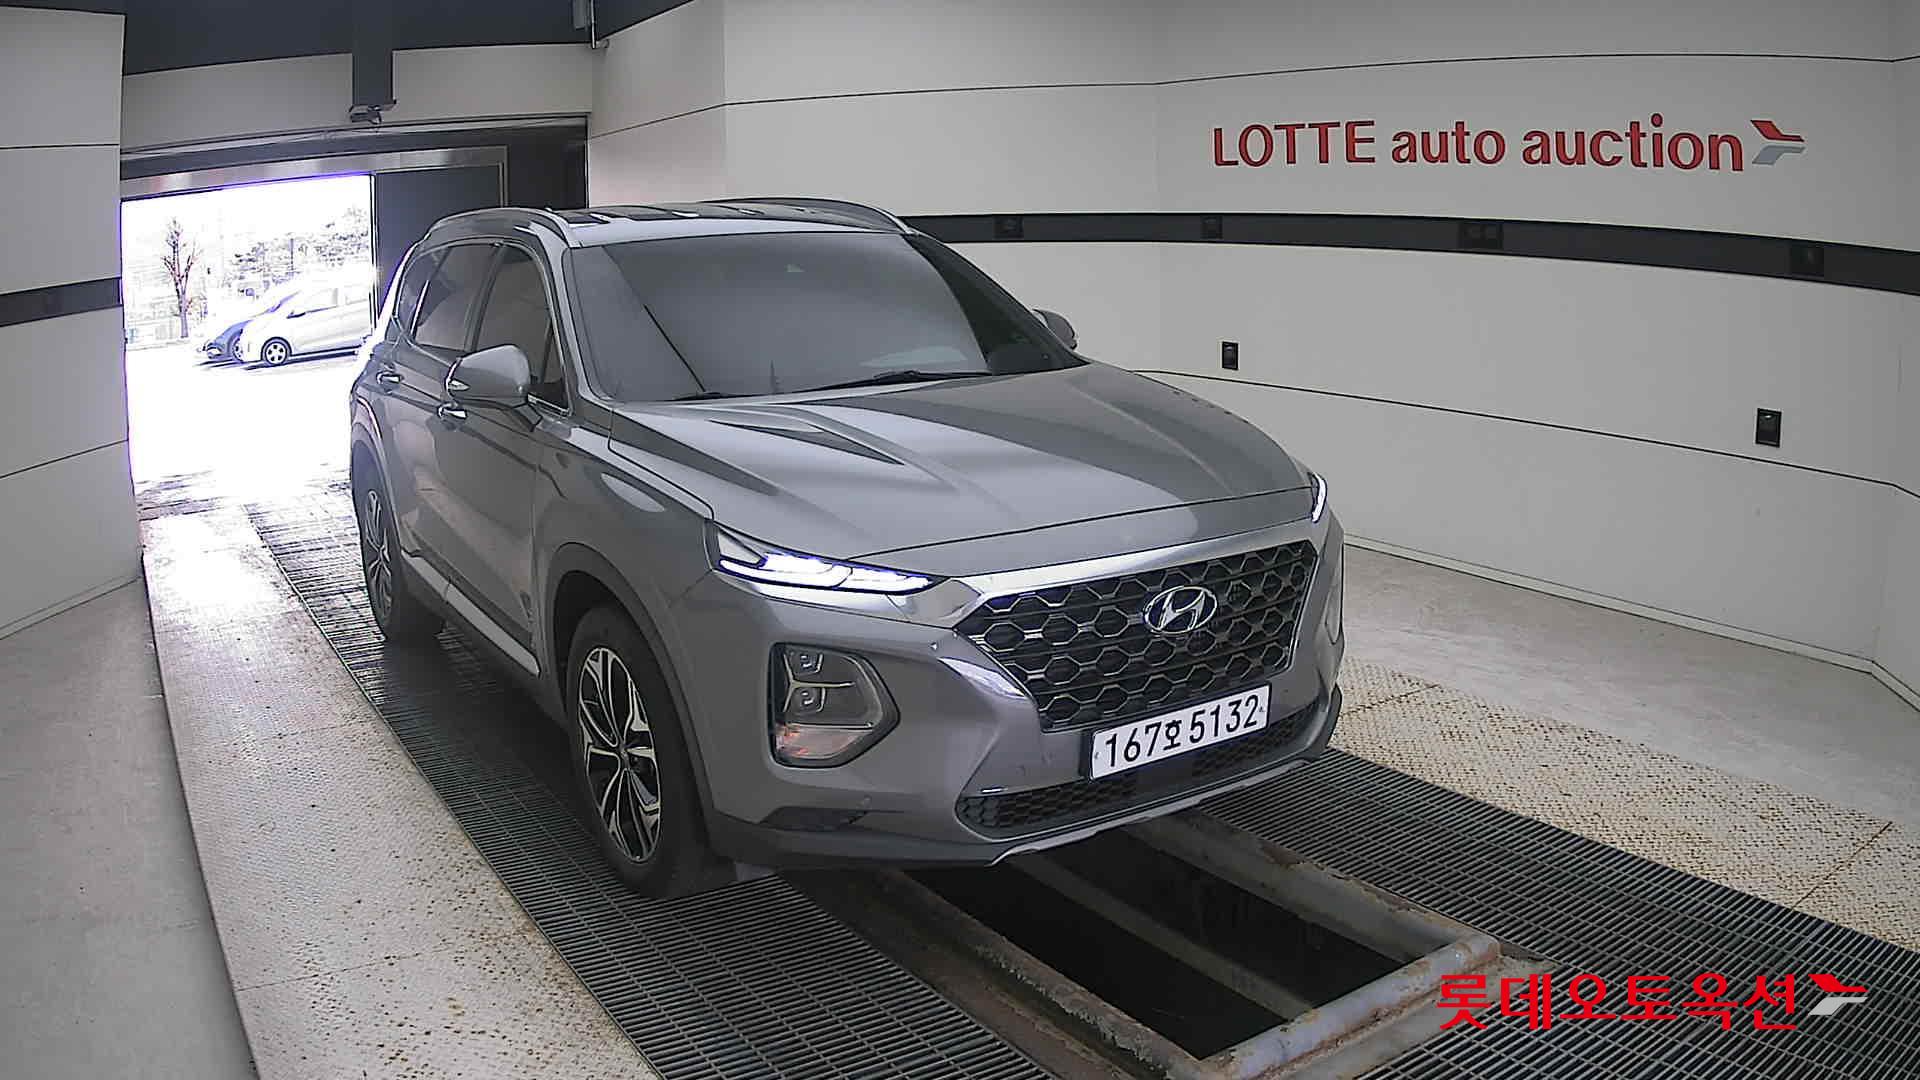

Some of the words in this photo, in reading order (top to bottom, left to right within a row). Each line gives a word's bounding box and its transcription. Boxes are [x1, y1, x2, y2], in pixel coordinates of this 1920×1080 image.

[1213, 120, 1376, 167] LOTTE
[1391, 120, 1506, 165] auto
[1521, 113, 1744, 172] auction
